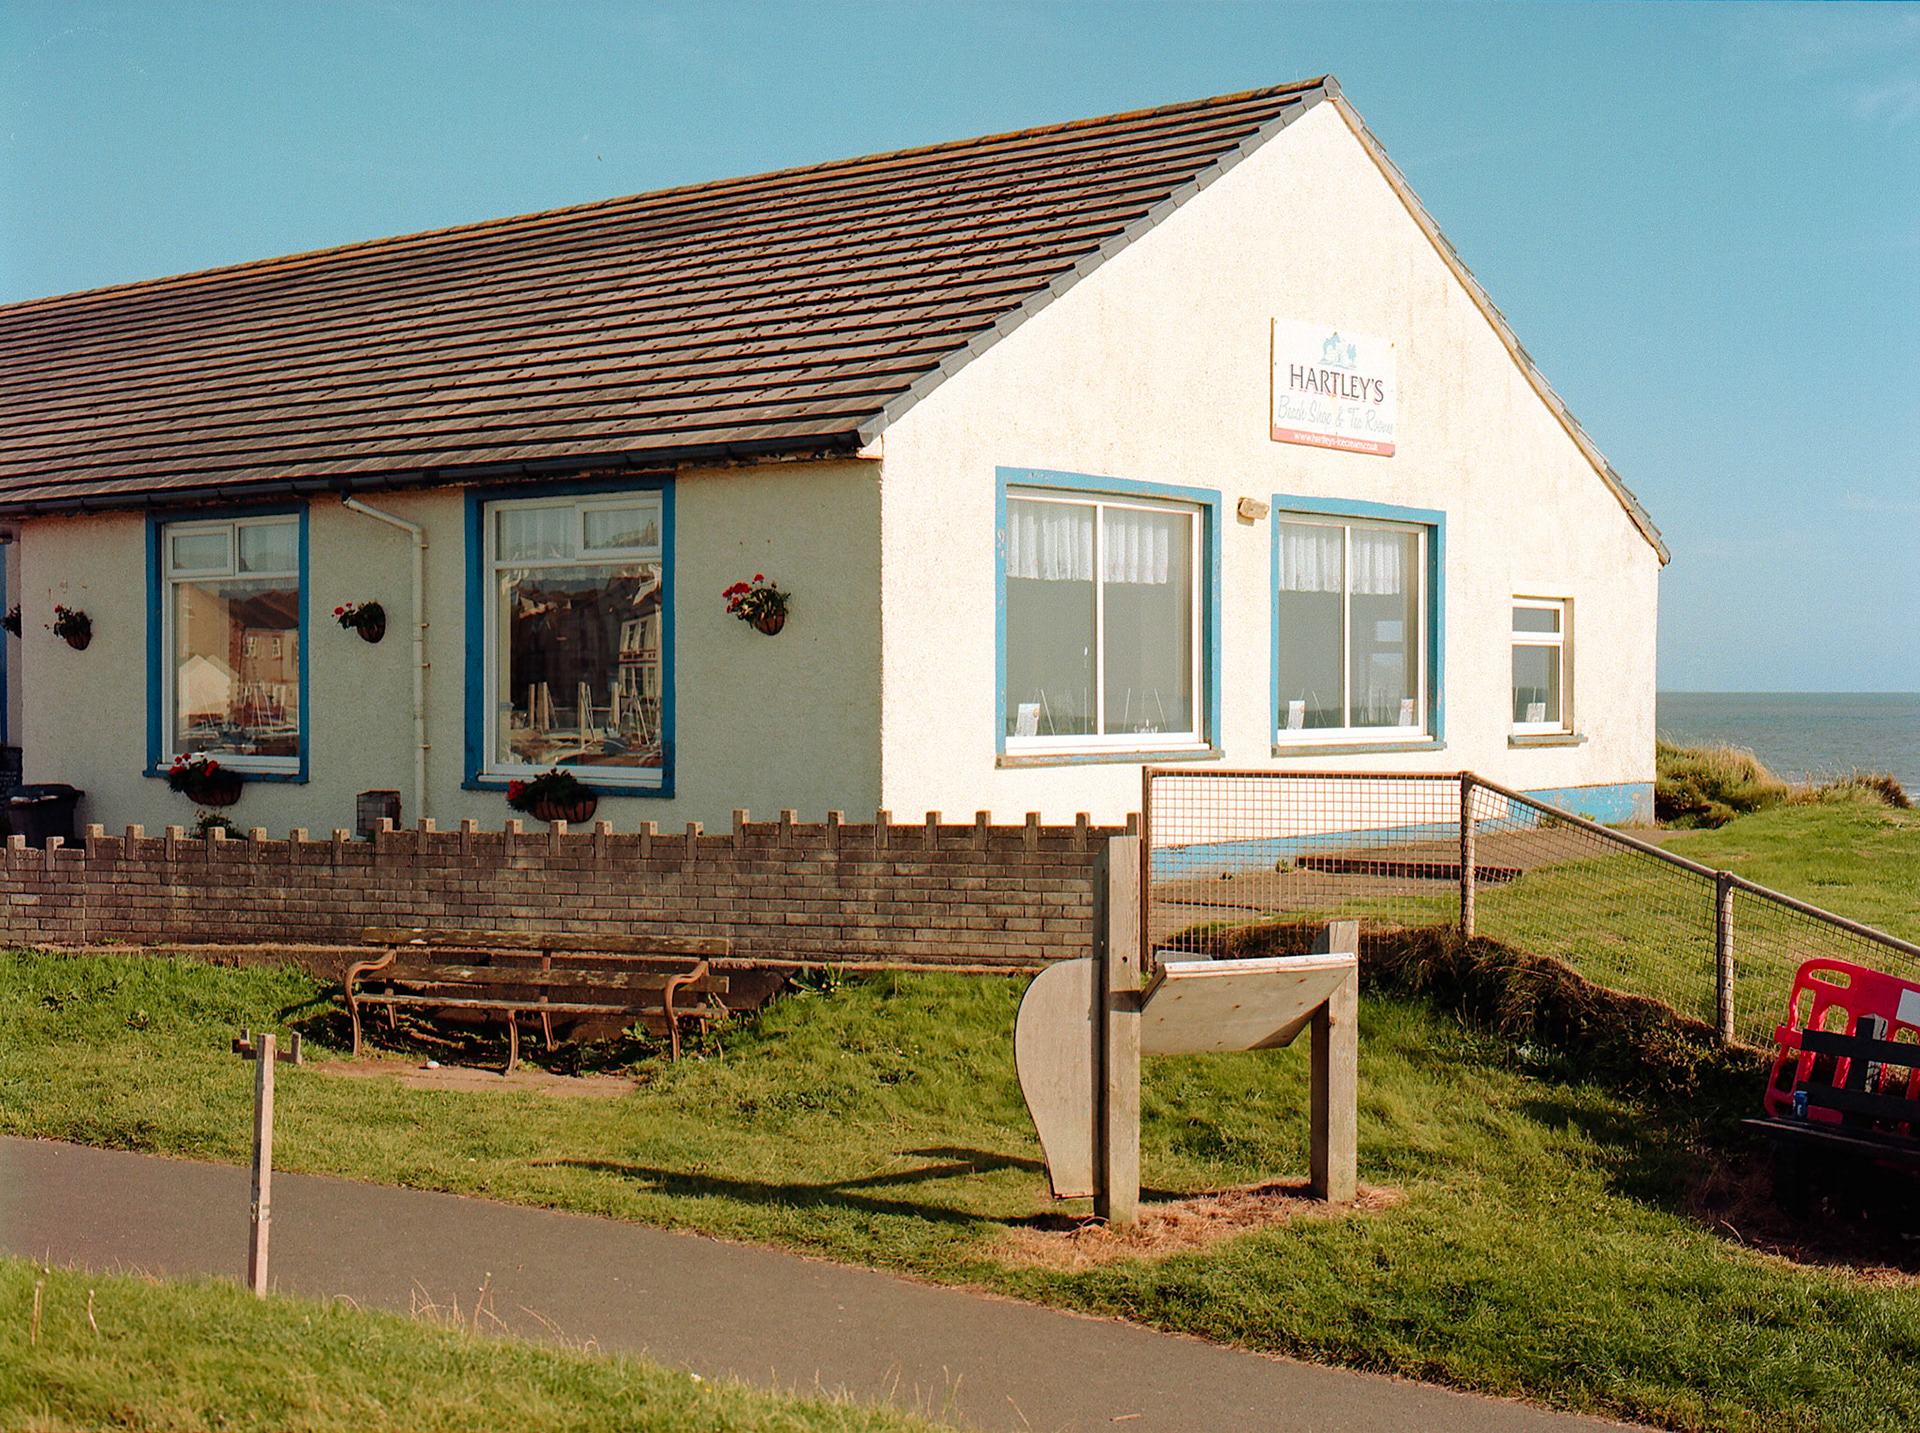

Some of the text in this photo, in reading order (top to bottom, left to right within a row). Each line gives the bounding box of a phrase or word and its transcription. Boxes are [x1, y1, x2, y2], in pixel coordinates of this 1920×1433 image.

[1289, 364, 1385, 404] HARTLEY'S
[1278, 395, 1306, 421] Beach
[1335, 406, 1344, 428] &
